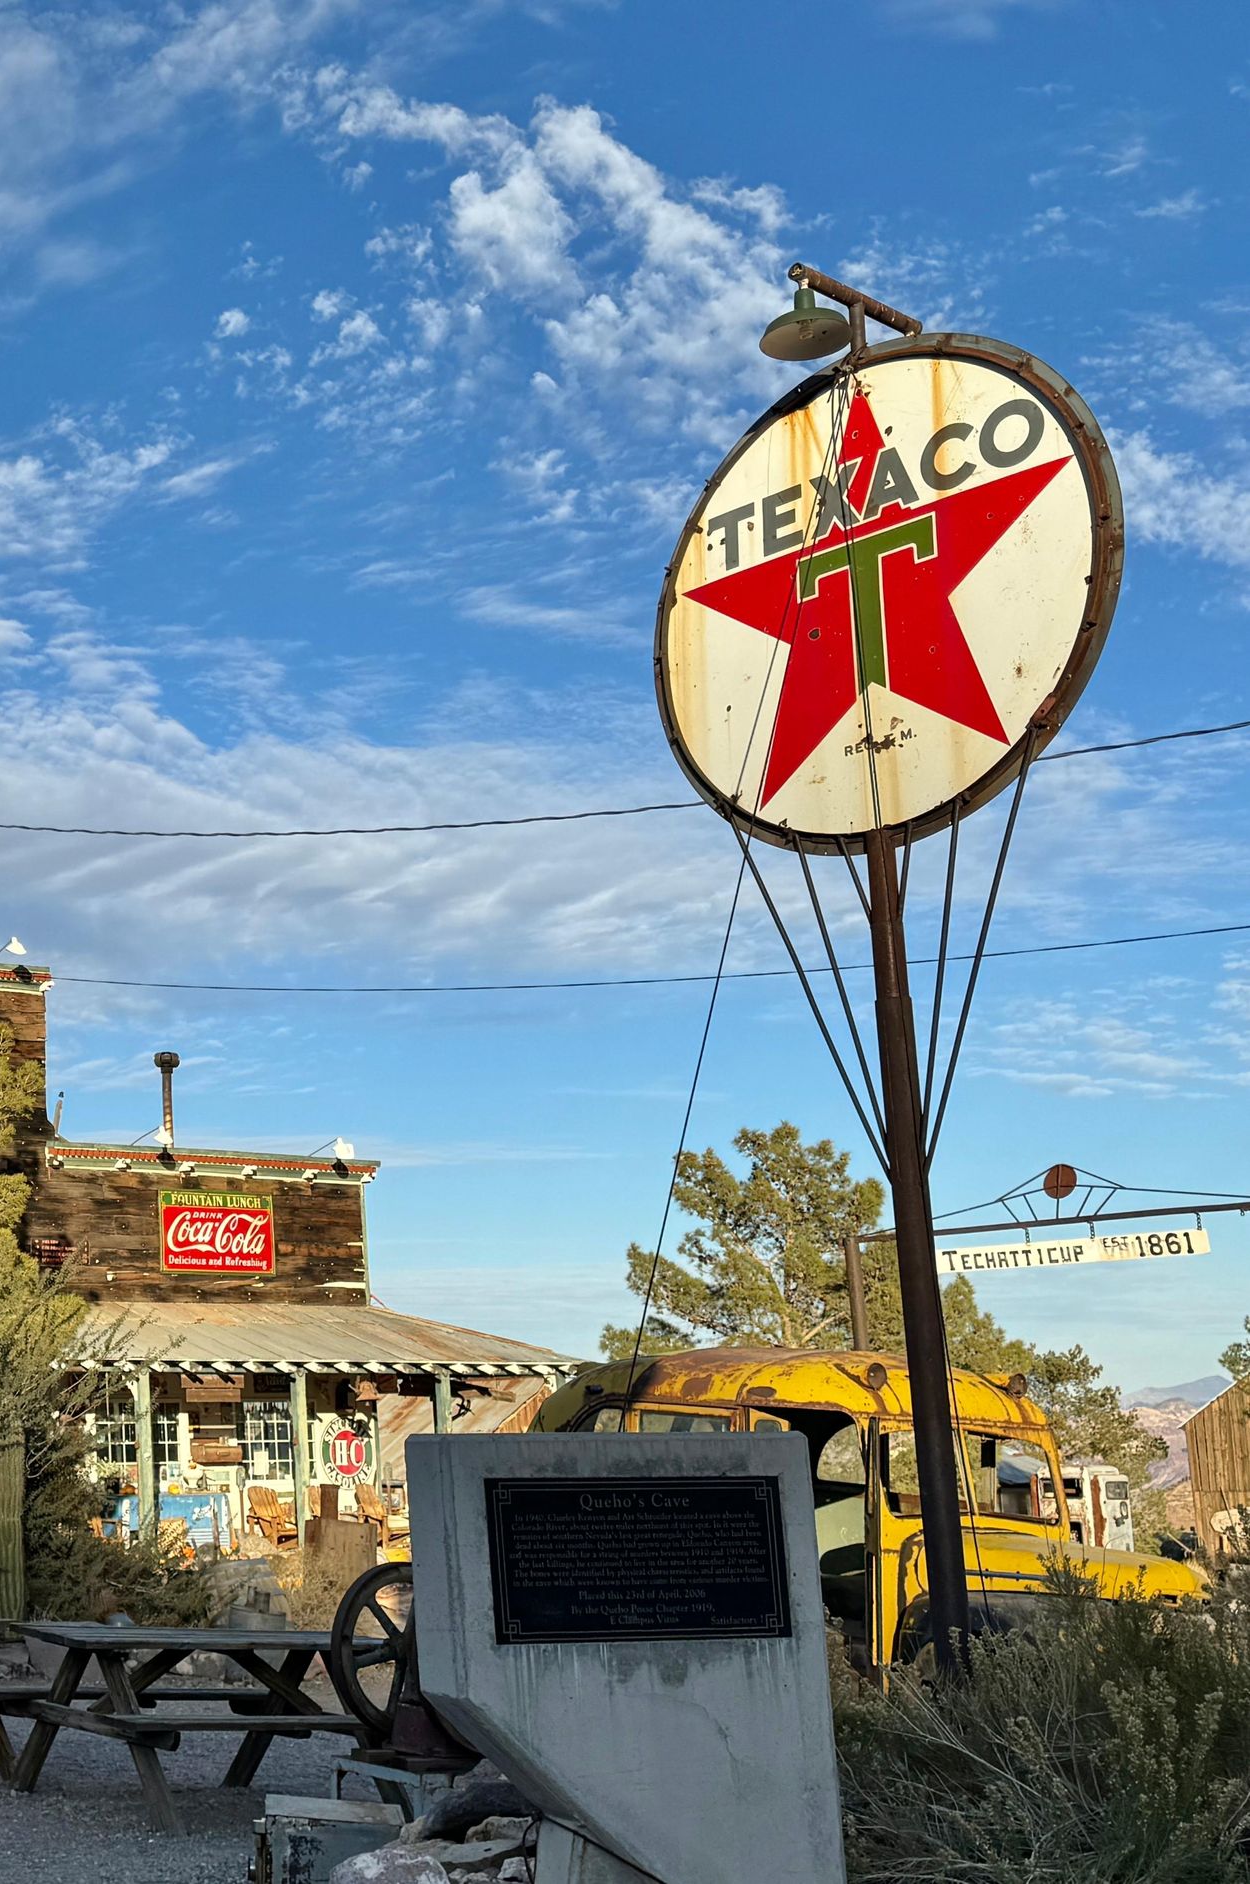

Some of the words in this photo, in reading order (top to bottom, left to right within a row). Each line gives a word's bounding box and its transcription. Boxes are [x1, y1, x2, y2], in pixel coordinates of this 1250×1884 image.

[708, 398, 1046, 571] TEXACO
[797, 511, 938, 696] T
[171, 1192, 223, 1207] FOUNTAIN
[227, 1195, 261, 1209] LUNCH
[192, 1211, 224, 1220] DRINK
[166, 1211, 270, 1255] Coca-Cola
[942, 1244, 1085, 1272] TECHATTICUP
[1135, 1231, 1194, 1258] 1861
[168, 1255, 207, 1266] Delicious
[208, 1256, 223, 1267] and
[225, 1256, 268, 1270] Refreshing
[580, 1493, 645, 1511] Queho's
[651, 1493, 690, 1507] Cave
[547, 1514, 575, 1522] Charles
[607, 1513, 620, 1521] and
[622, 1513, 634, 1521] Art
[673, 1512, 698, 1520] located
[722, 1511, 742, 1519] above
[744, 1511, 755, 1519] the
[511, 1523, 544, 1532] Colorado
[570, 1523, 589, 1531] about
[591, 1522, 614, 1530] twelve
[616, 1522, 634, 1530] miles
[670, 1521, 678, 1529] of
[680, 1521, 693, 1529] this
[713, 1521, 721, 1529] In
[748, 1520, 759, 1528] the
[513, 1533, 541, 1541] remains
[552, 1532, 584, 1540] southern
[585, 1532, 618, 1540] Nevada's
[619, 1531, 632, 1539] last
[634, 1531, 651, 1541] great
[715, 1530, 730, 1538] who
[731, 1530, 744, 1538] had
[746, 1529, 762, 1537] been
[515, 1542, 531, 1550] dead
[533, 1542, 553, 1550] about
[597, 1541, 622, 1551] Queho
[661, 1542, 671, 1550] up
[672, 1540, 680, 1548] in
[714, 1539, 741, 1549] Canyon
[580, 1550, 590, 1558] for
[599, 1550, 619, 1560] string
[620, 1550, 628, 1558] of
[630, 1549, 658, 1558] murders
[660, 1549, 689, 1557] between
[711, 1548, 724, 1556] and
[748, 1548, 766, 1556] After
[532, 1560, 544, 1568] last
[576, 1560, 585, 1568] he
[624, 1559, 632, 1567] to
[634, 1559, 646, 1567] live
[648, 1559, 656, 1567] in
[686, 1558, 697, 1566] for
[698, 1558, 725, 1566] another
[515, 1570, 528, 1578] The
[530, 1570, 550, 1578] bones
[606, 1569, 614, 1579] by
[617, 1568, 646, 1578] physical
[701, 1567, 714, 1575] and
[745, 1567, 765, 1575] found
[522, 1579, 534, 1587] the
[553, 1579, 575, 1587] which
[596, 1578, 621, 1586] known
[622, 1578, 630, 1586] to
[631, 1578, 648, 1586] have
[670, 1577, 686, 1585] from
[715, 1576, 740, 1584] murder
[579, 1591, 606, 1600] Placed
[608, 1591, 623, 1600] this
[626, 1591, 645, 1600] 23rd
[647, 1591, 655, 1599] of
[685, 1590, 706, 1599] 2006
[571, 1605, 582, 1616] By
[585, 1605, 598, 1614] the
[600, 1605, 629, 1615] Queho
[631, 1604, 654, 1613] Posse
[656, 1604, 688, 1615] Chapter
[609, 1616, 616, 1625] E
[618, 1616, 655, 1626] Clampus
